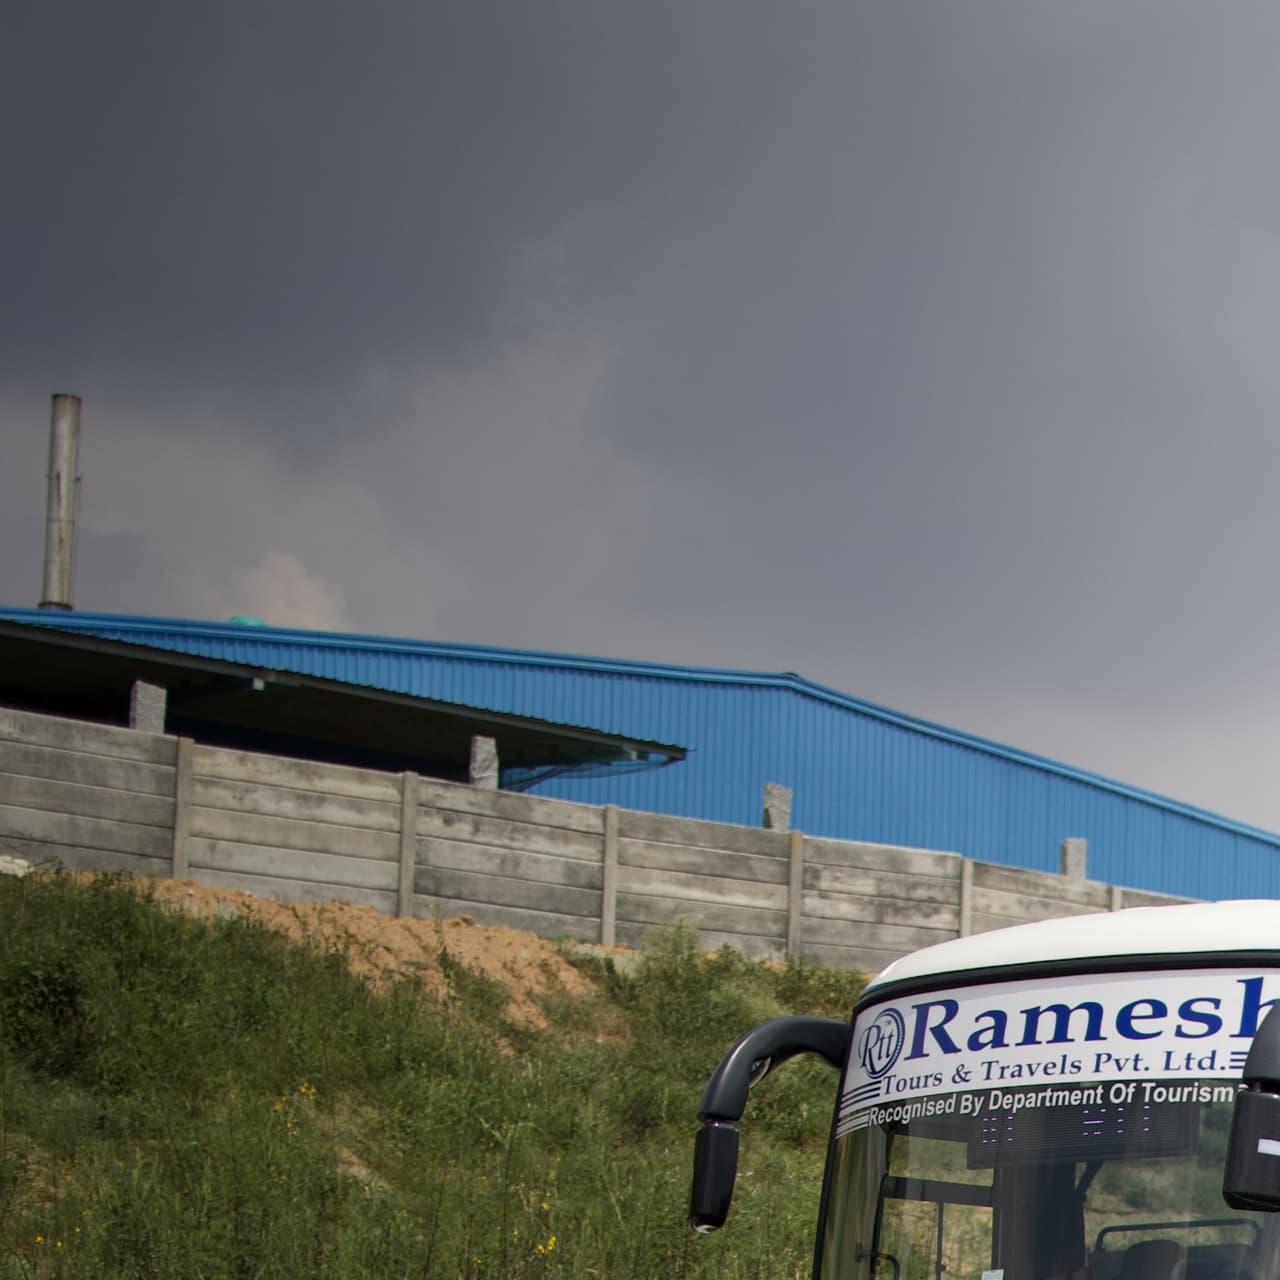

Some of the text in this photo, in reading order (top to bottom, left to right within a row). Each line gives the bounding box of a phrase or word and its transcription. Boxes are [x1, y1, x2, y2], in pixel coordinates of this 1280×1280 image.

[882, 1050, 1227, 1095] Tours & Travels Pvt. Ltd.
[868, 1093, 957, 1127] Recognised
[960, 1094, 984, 1116] By
[989, 1086, 1103, 1113] Department
[1109, 1083, 1133, 1104] Of
[1141, 1082, 1234, 1104] Tourism
